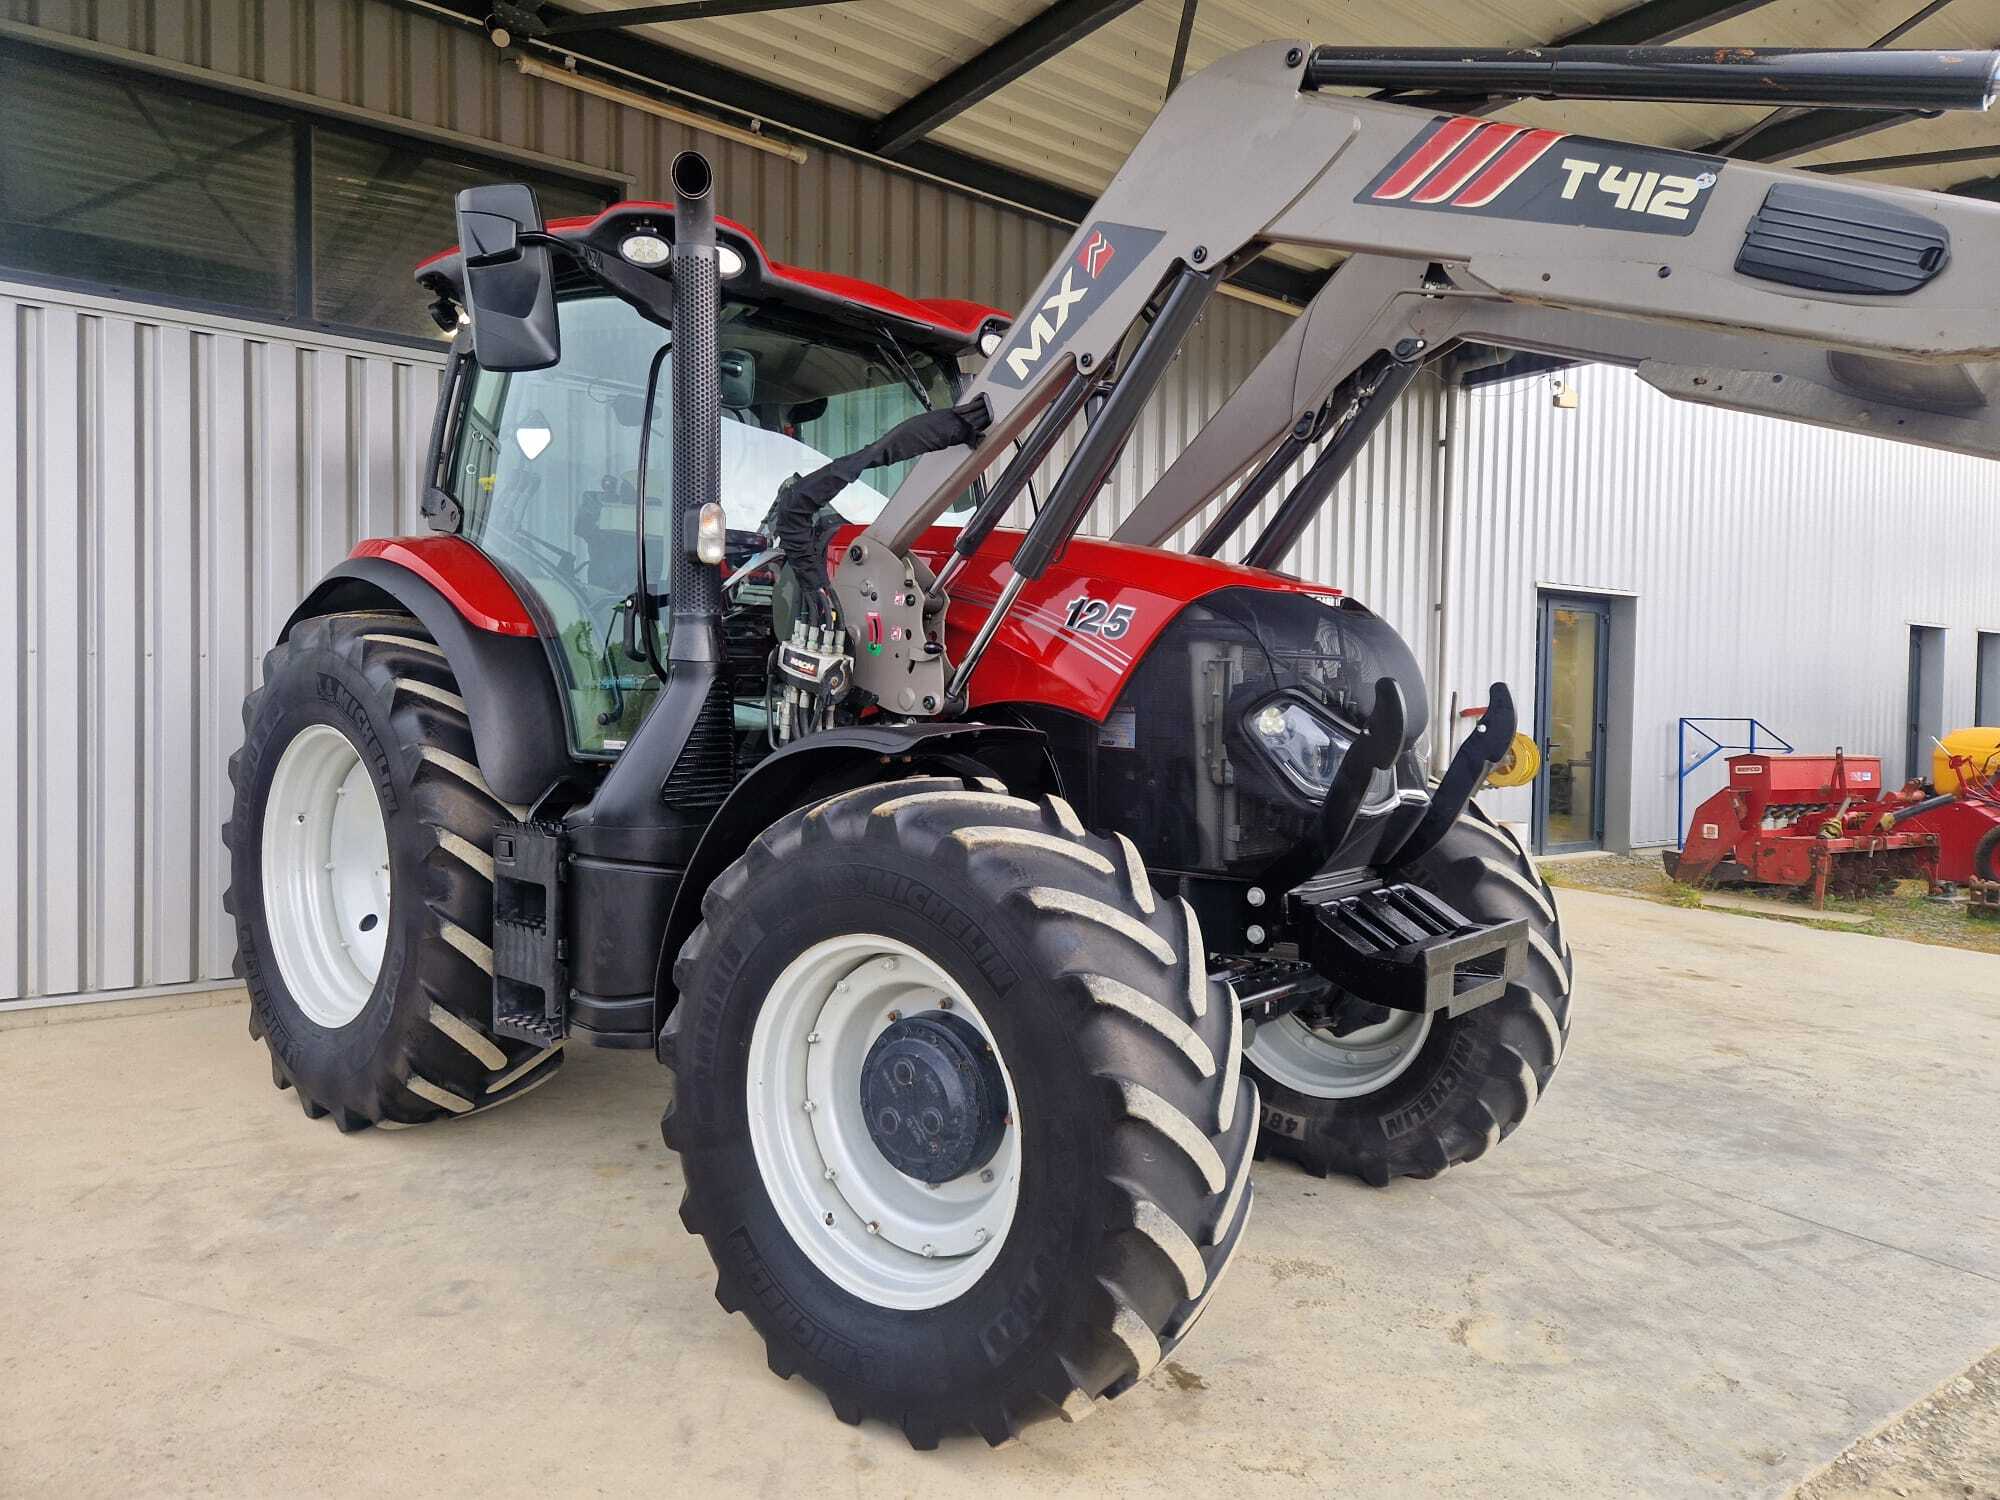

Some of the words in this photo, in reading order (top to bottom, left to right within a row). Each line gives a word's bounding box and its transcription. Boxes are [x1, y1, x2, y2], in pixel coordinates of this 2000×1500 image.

[1561, 158, 1699, 220] T412
[1006, 267, 1089, 381] MX
[1064, 595, 1136, 640] 125
[336, 684, 399, 817] MICHELIN
[864, 868, 1017, 997] MICHELIN
[1382, 1031, 1477, 1139] MICHELIN
